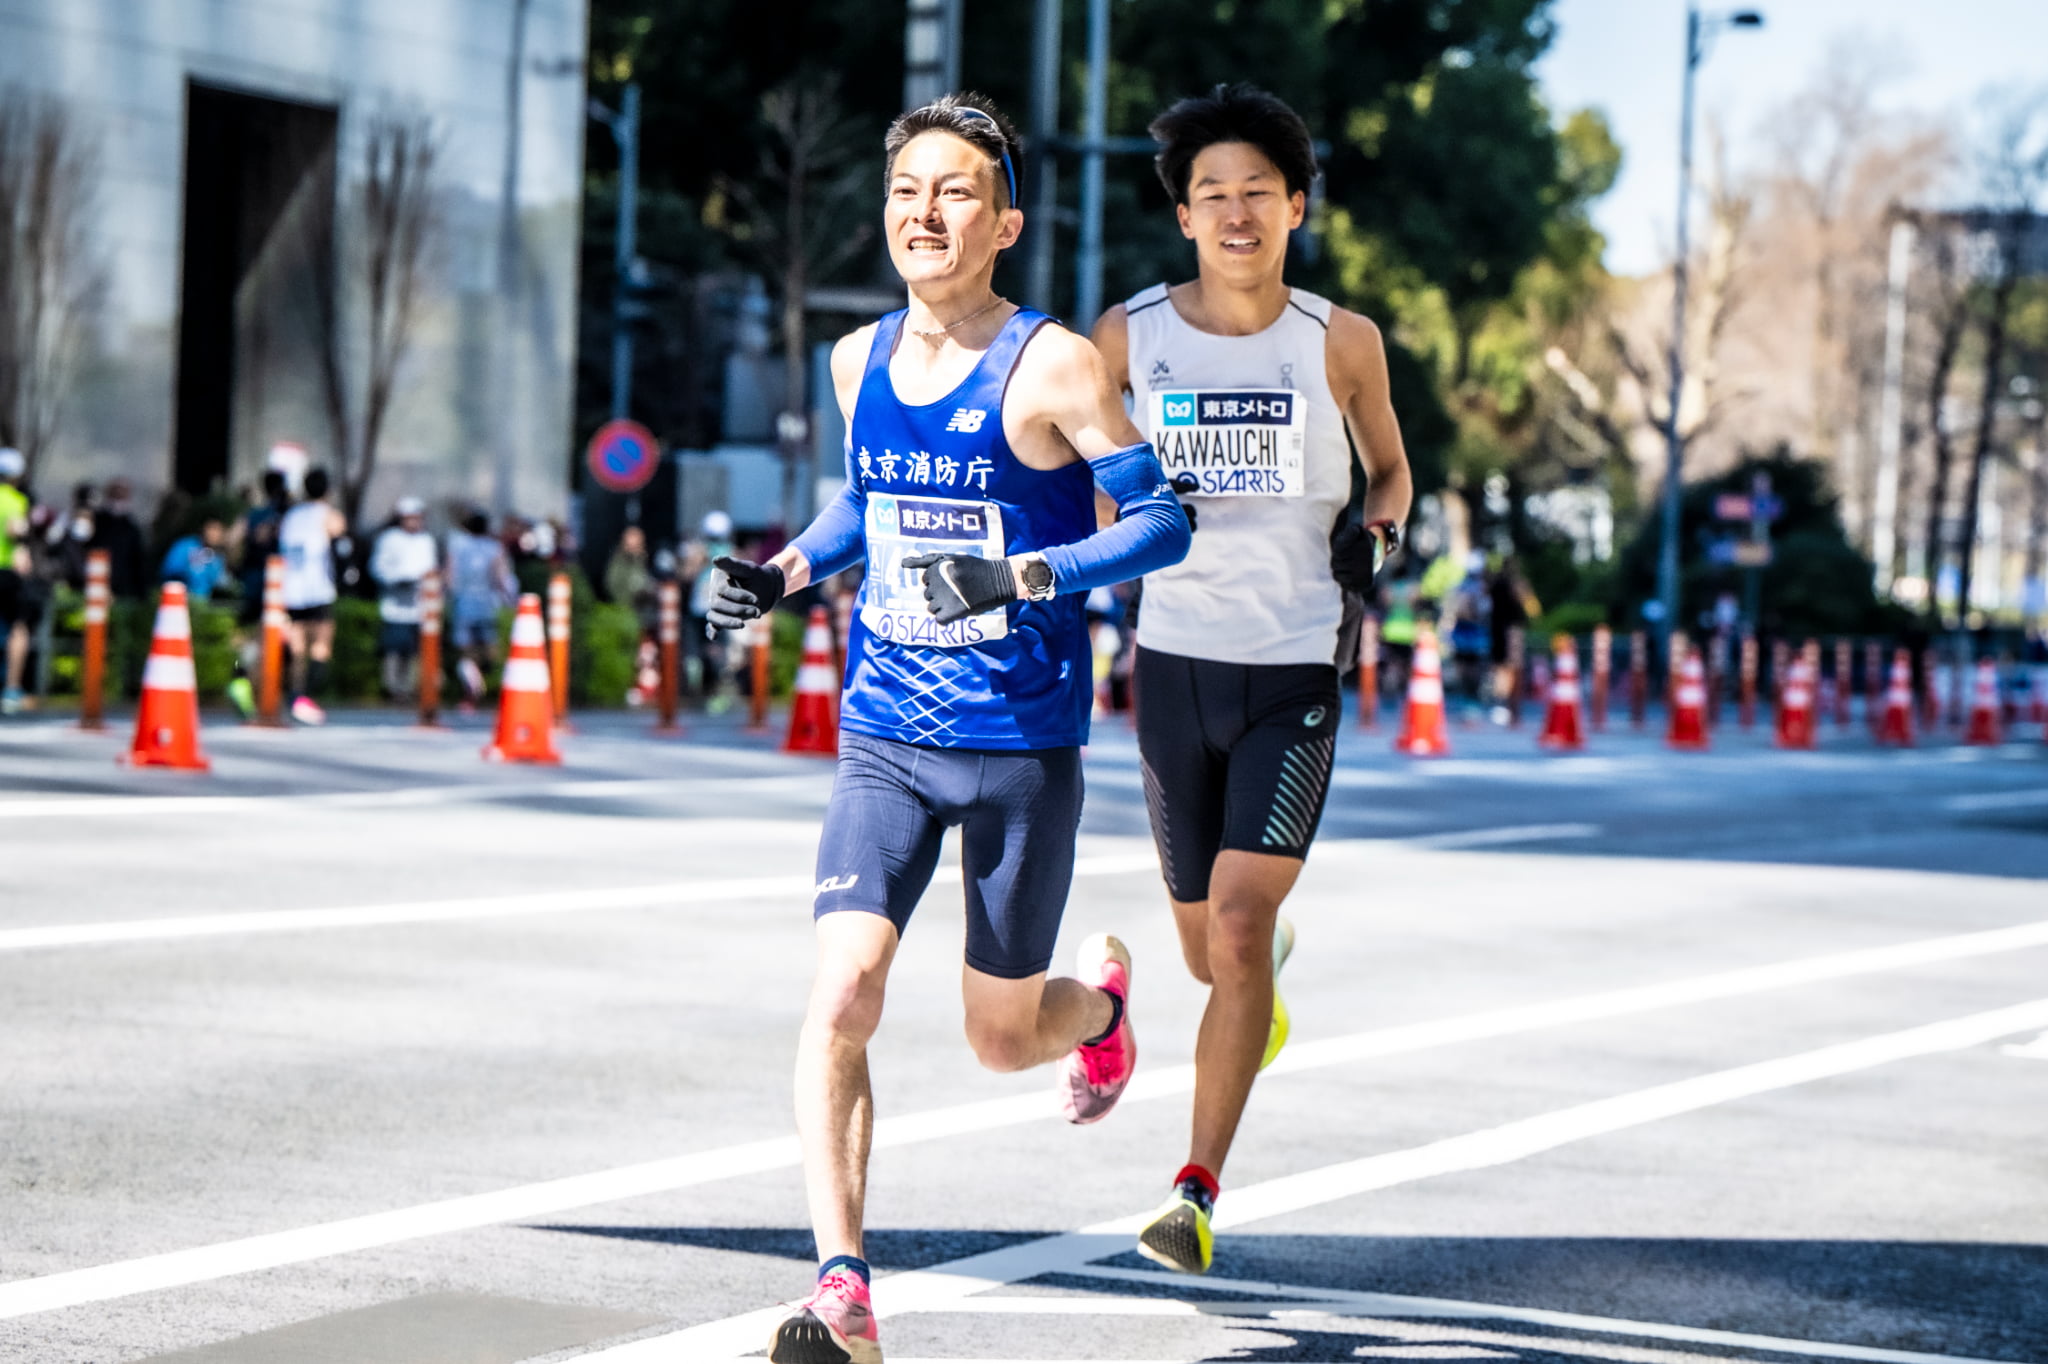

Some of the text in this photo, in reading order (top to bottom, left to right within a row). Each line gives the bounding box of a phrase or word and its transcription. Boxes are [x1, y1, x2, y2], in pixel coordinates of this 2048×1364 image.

[1202, 400, 1287, 418] 東京メトロ
[1157, 429, 1278, 468] KAWAUCHI
[858, 446, 994, 491] 東京消防庁
[1202, 469, 1285, 494] STARTS
[901, 510, 981, 532] 東京メトロ
[896, 614, 984, 644] STARTS
